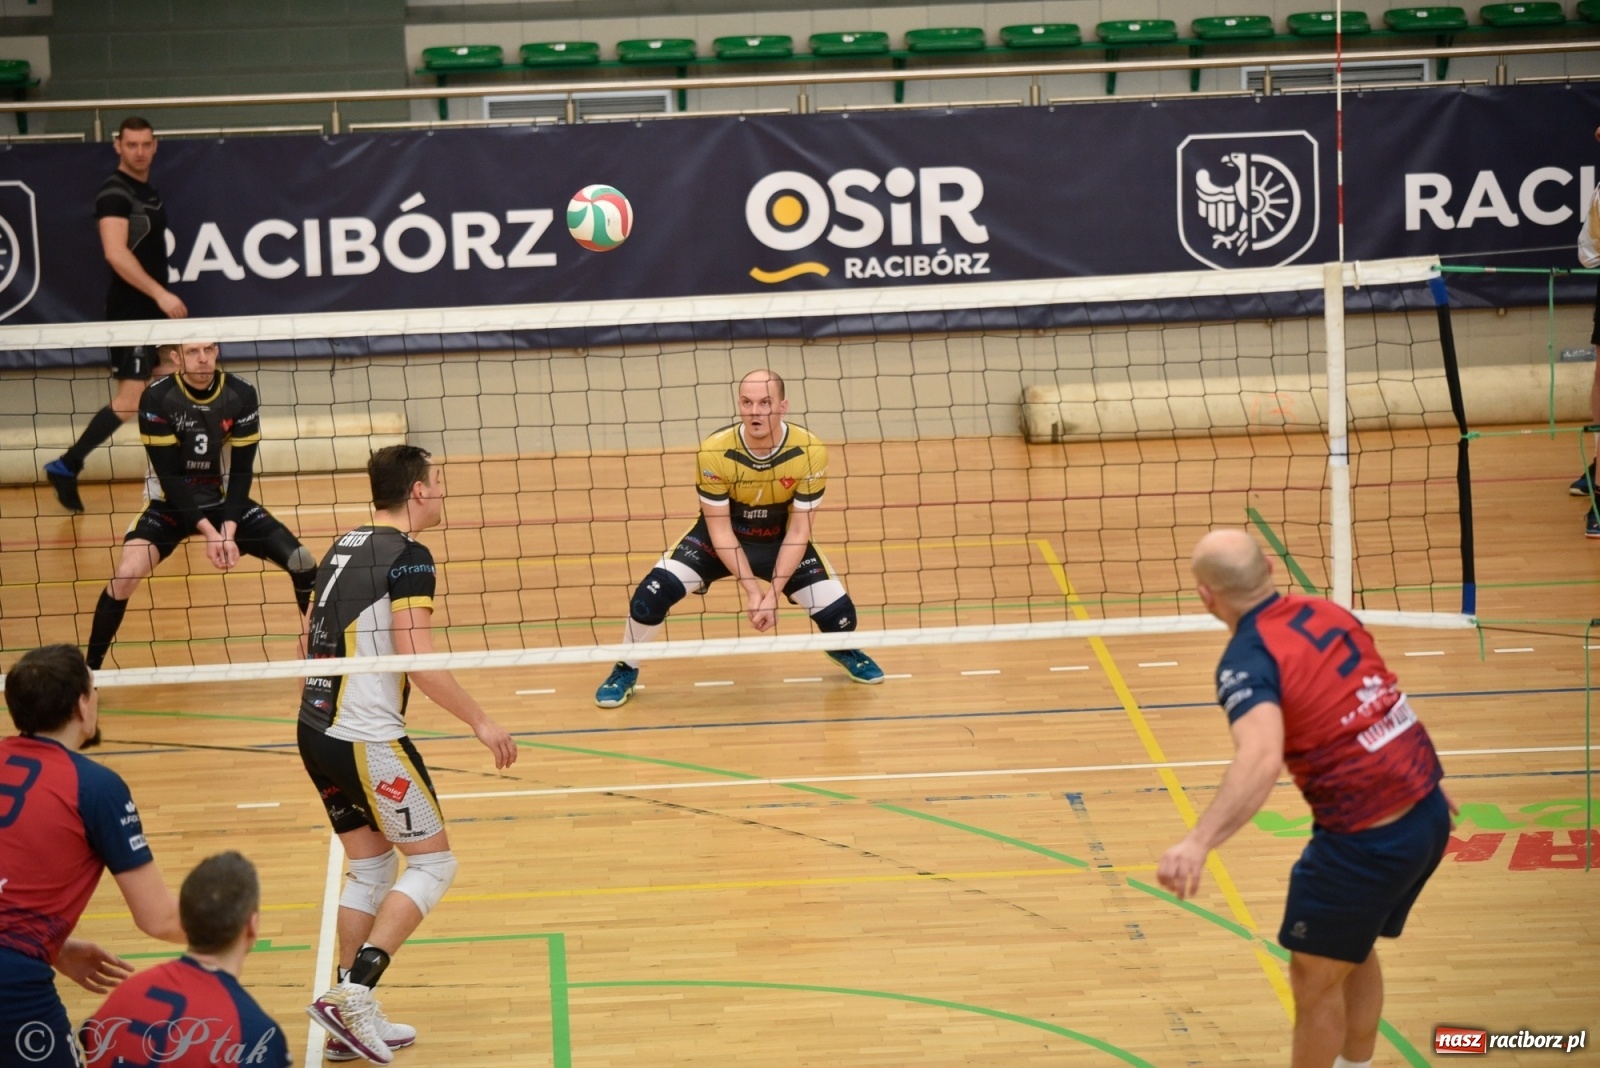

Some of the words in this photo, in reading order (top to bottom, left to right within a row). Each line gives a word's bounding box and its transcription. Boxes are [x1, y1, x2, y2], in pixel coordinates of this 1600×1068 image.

[844, 248, 991, 280] RACIBÓRZ
[194, 433, 209, 455] 3
[743, 509, 769, 519] ENTER
[337, 530, 374, 547] ENTER
[318, 554, 352, 607] 7
[1287, 604, 1362, 678] 5
[380, 783, 402, 797] Enter
[395, 807, 413, 831] 7
